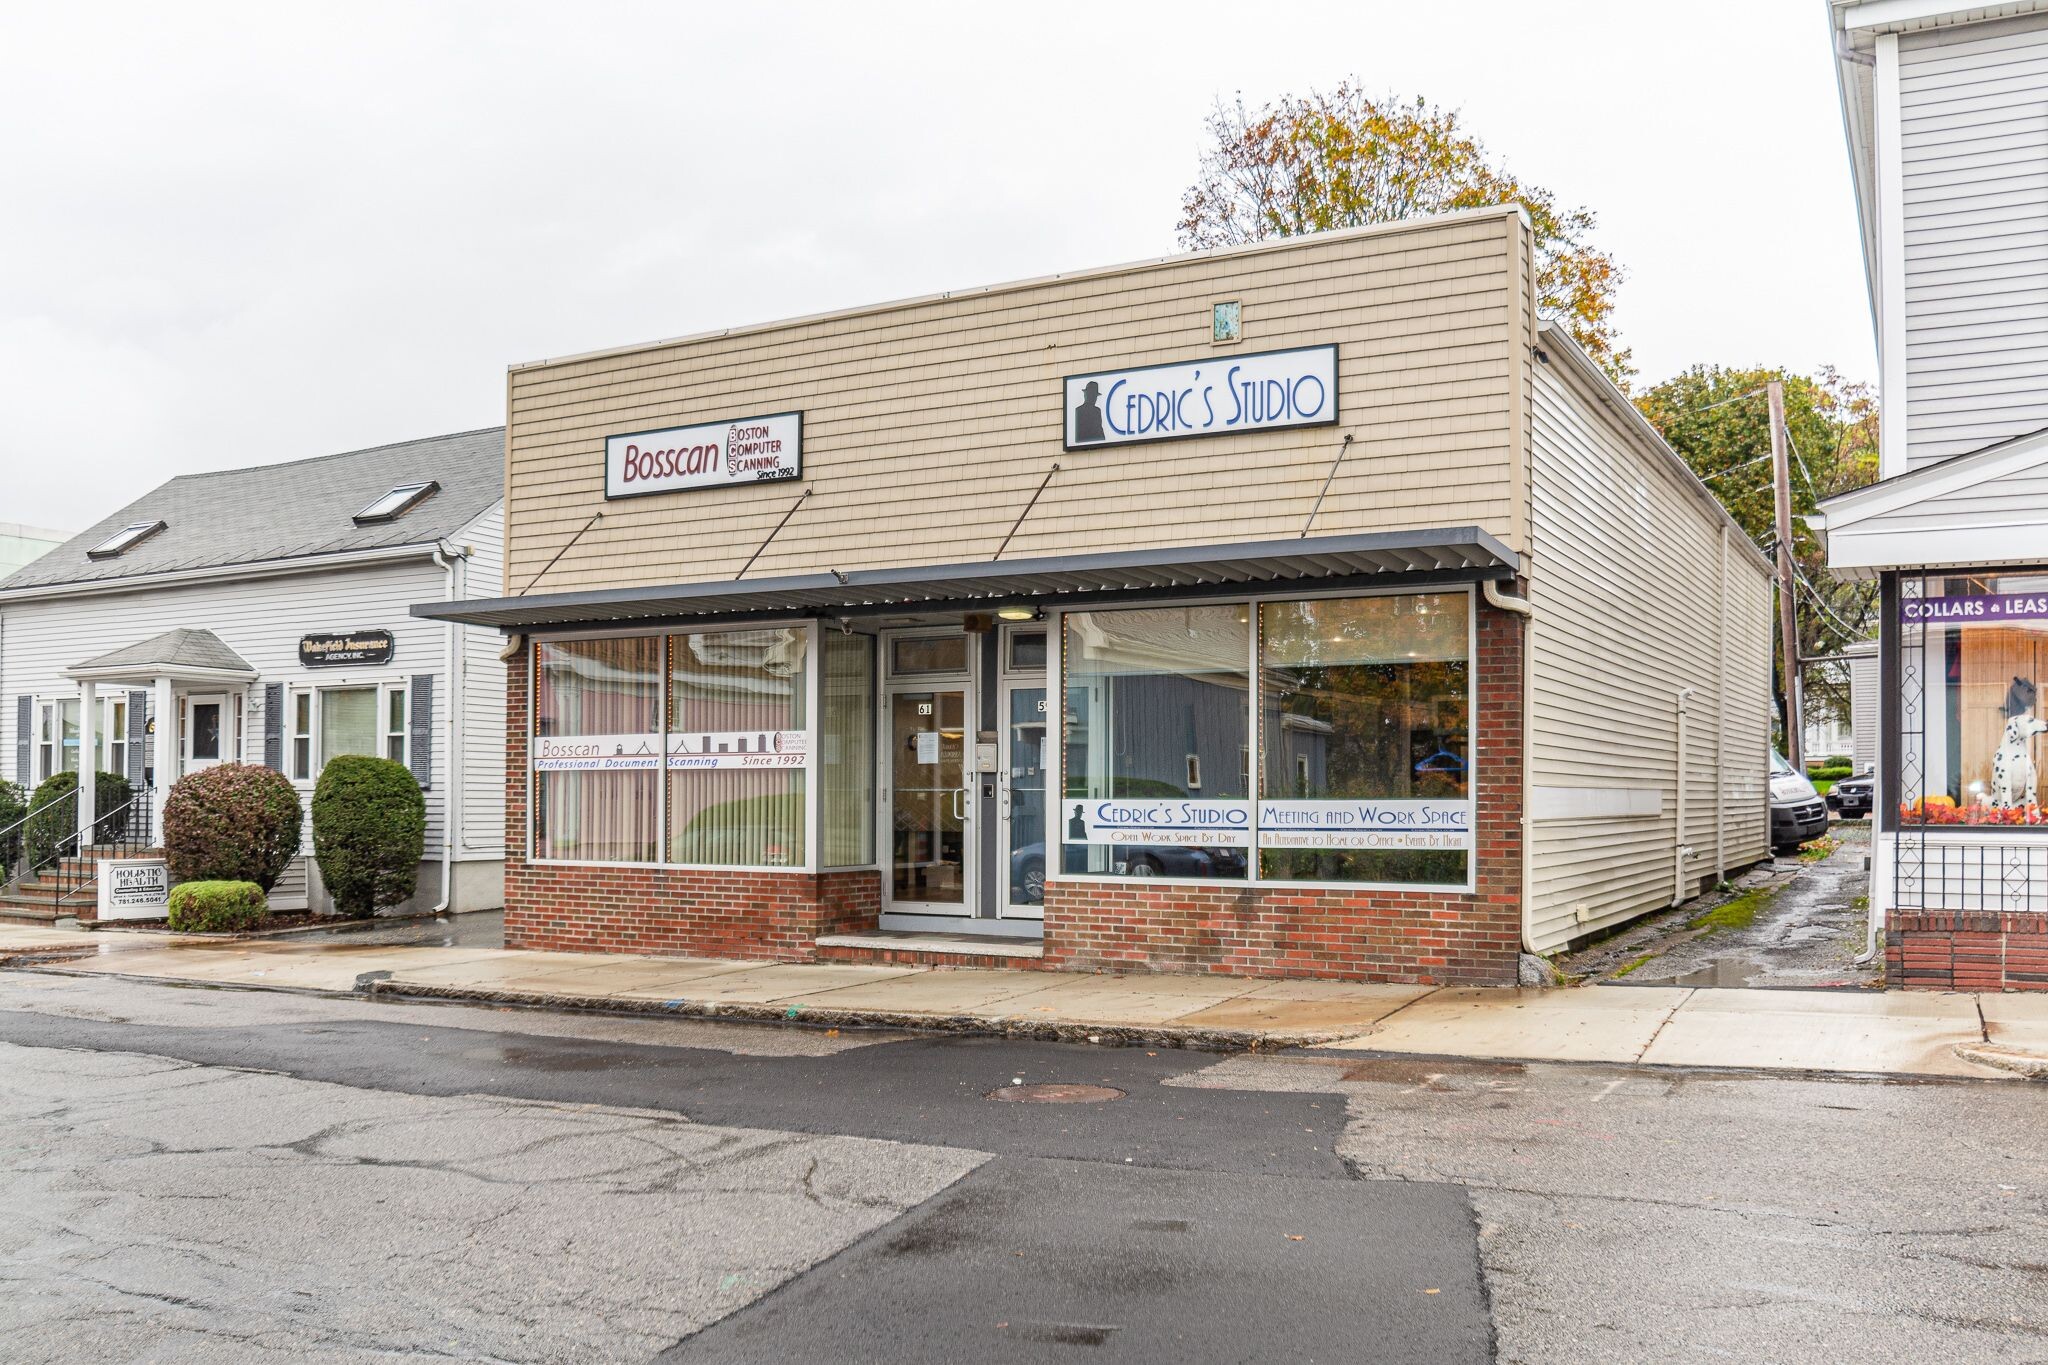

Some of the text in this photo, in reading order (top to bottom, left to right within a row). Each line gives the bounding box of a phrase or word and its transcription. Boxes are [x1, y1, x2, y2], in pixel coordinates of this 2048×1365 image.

[1105, 365, 1325, 435] CEDRIC'S STUDIO
[730, 426, 769, 442] BOSTON
[729, 440, 782, 457] COMPUTER
[623, 443, 719, 483] Bosscan
[729, 456, 780, 474] SCANNING
[757, 467, 795, 480] Since 1992
[1904, 600, 1984, 618] COLLARS
[345, 638, 388, 650] Insurance
[919, 704, 930, 714] 61
[542, 739, 600, 757] Bosscan
[537, 757, 719, 769] Professional Document Scanning
[742, 755, 805, 765] Since 1992
[1097, 802, 1248, 824] CEDRIC'S STUDIO
[1262, 807, 1467, 825] MEETING AND WORK SPACE
[1111, 831, 1138, 842] OPEN
[1142, 831, 1171, 842] WORK
[1174, 831, 1197, 843] SPACE
[1218, 832, 1236, 843] DAY
[1405, 834, 1426, 847] EVENTS
[116, 868, 162, 879] HOLISTIC
[120, 876, 159, 887] HEALTH
